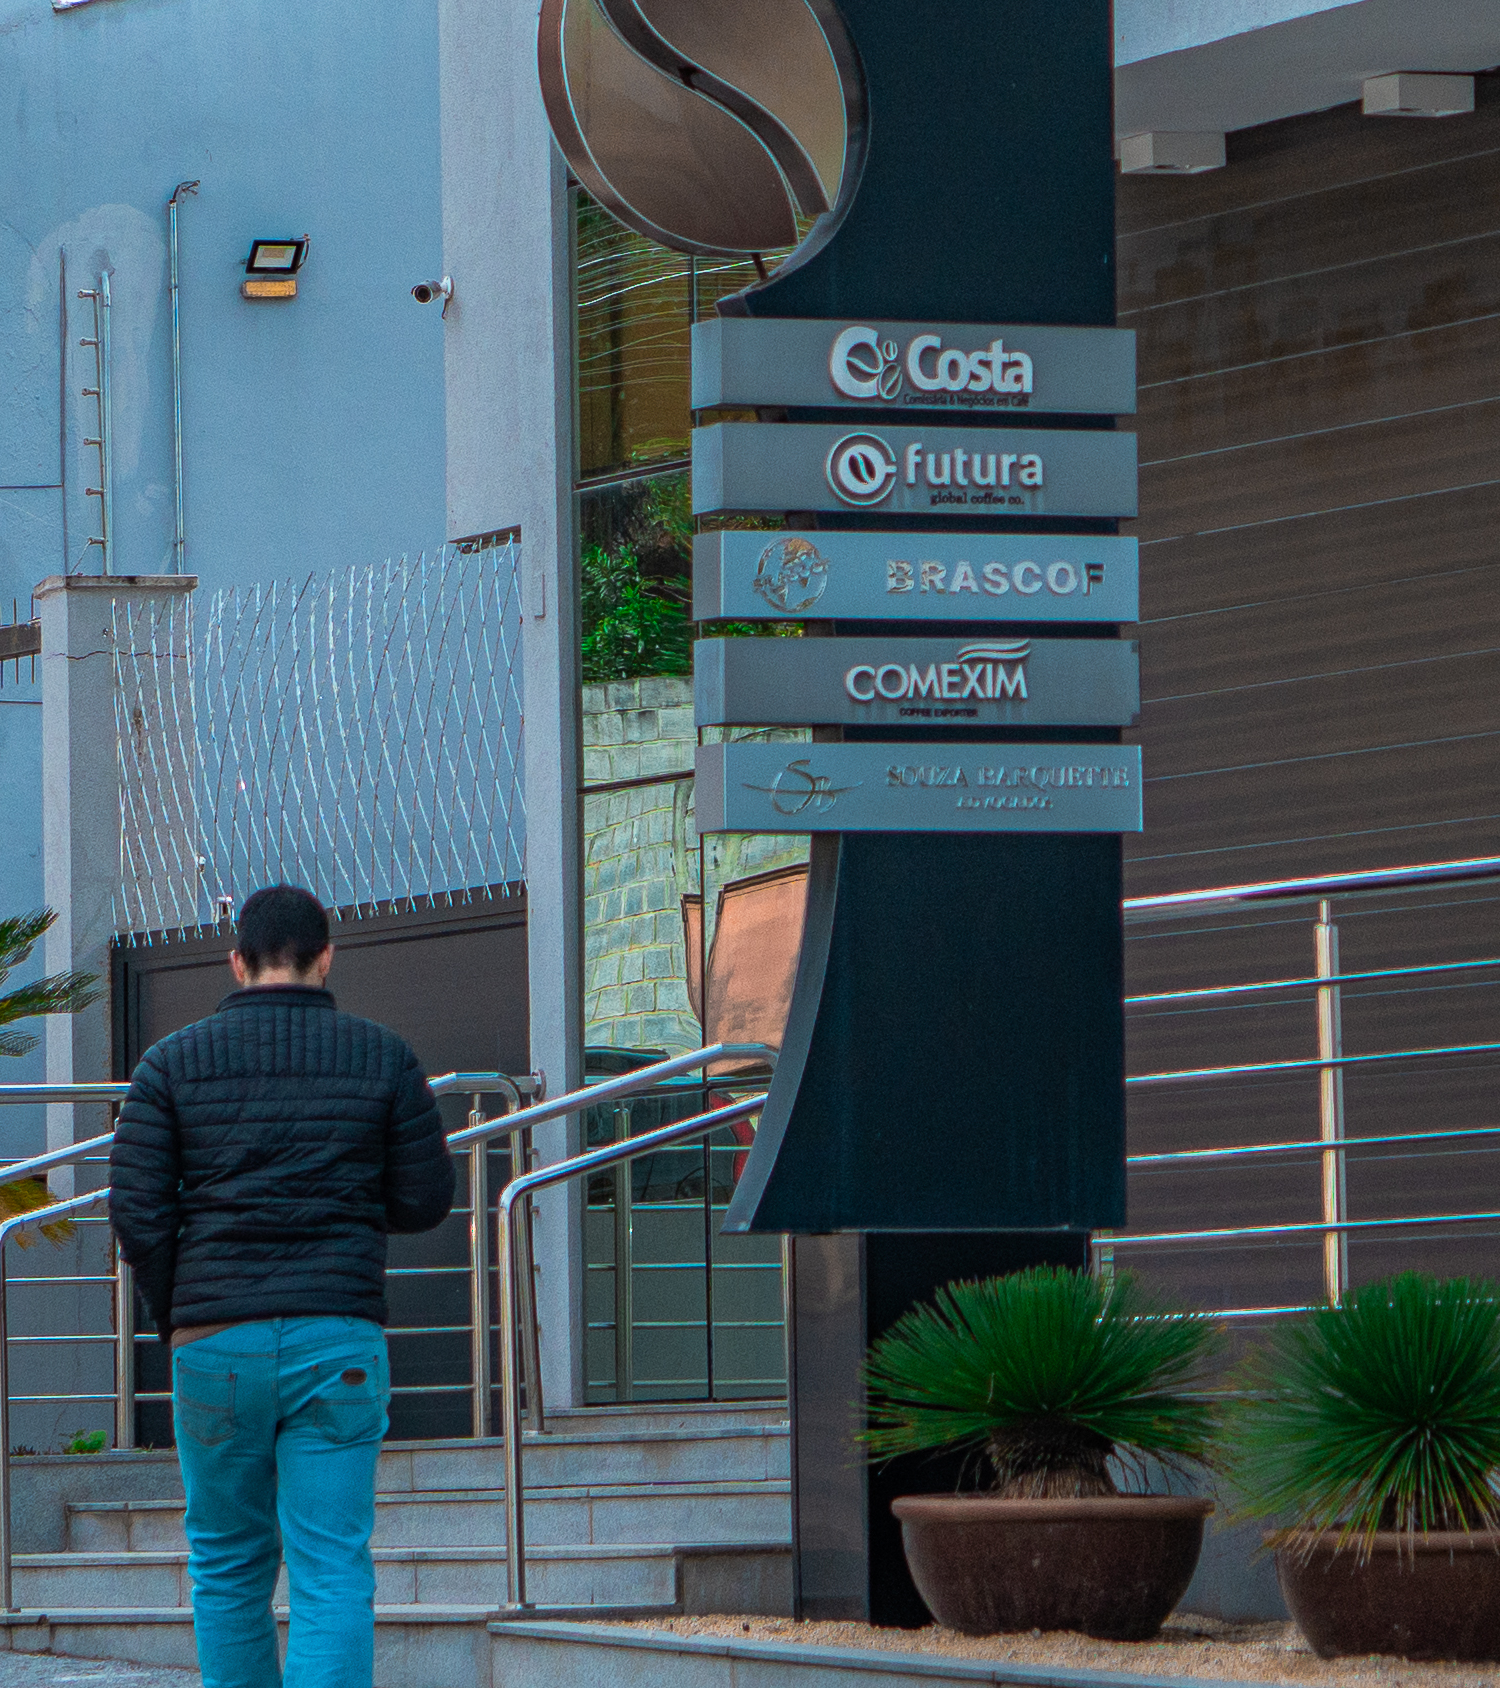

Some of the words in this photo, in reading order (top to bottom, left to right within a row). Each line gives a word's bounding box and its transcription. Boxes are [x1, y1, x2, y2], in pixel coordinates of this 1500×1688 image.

[907, 334, 1033, 394] Costa
[904, 442, 1044, 487] futura
[930, 491, 968, 506] global
[971, 492, 1005, 505] coffee
[887, 561, 1105, 596] BRASCOF
[845, 663, 1029, 702] COMEXIM
[886, 765, 968, 788] SOUZA
[977, 765, 1130, 792] BARQUETTE
